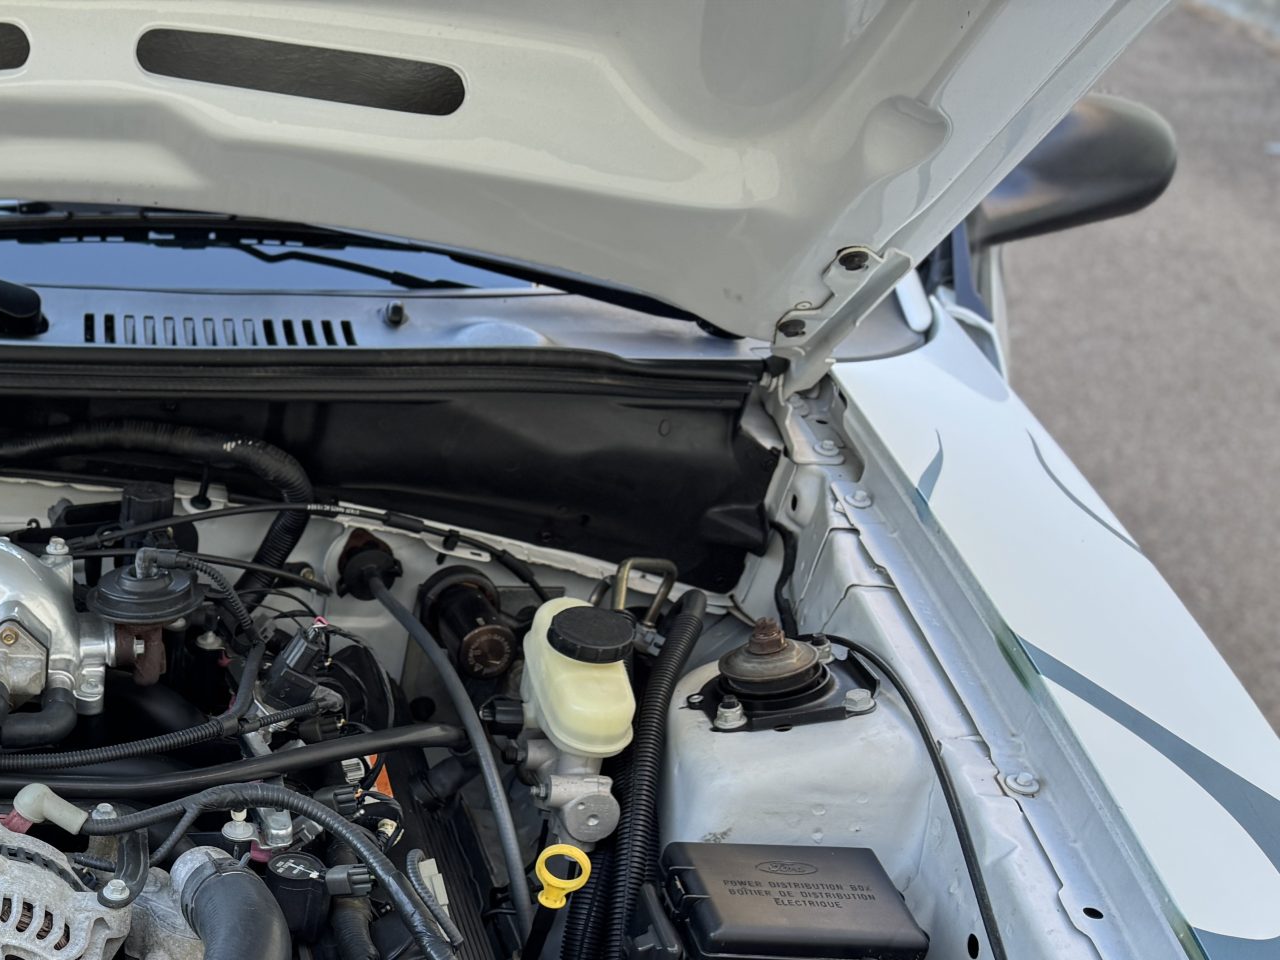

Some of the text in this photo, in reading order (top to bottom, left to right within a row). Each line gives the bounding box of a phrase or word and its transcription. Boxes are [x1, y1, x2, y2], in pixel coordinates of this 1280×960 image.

[723, 879, 762, 887] POWER
[768, 881, 843, 891] DISTRIBUTION
[779, 890, 793, 898] DE
[800, 891, 876, 901] DISTRIBUTION
